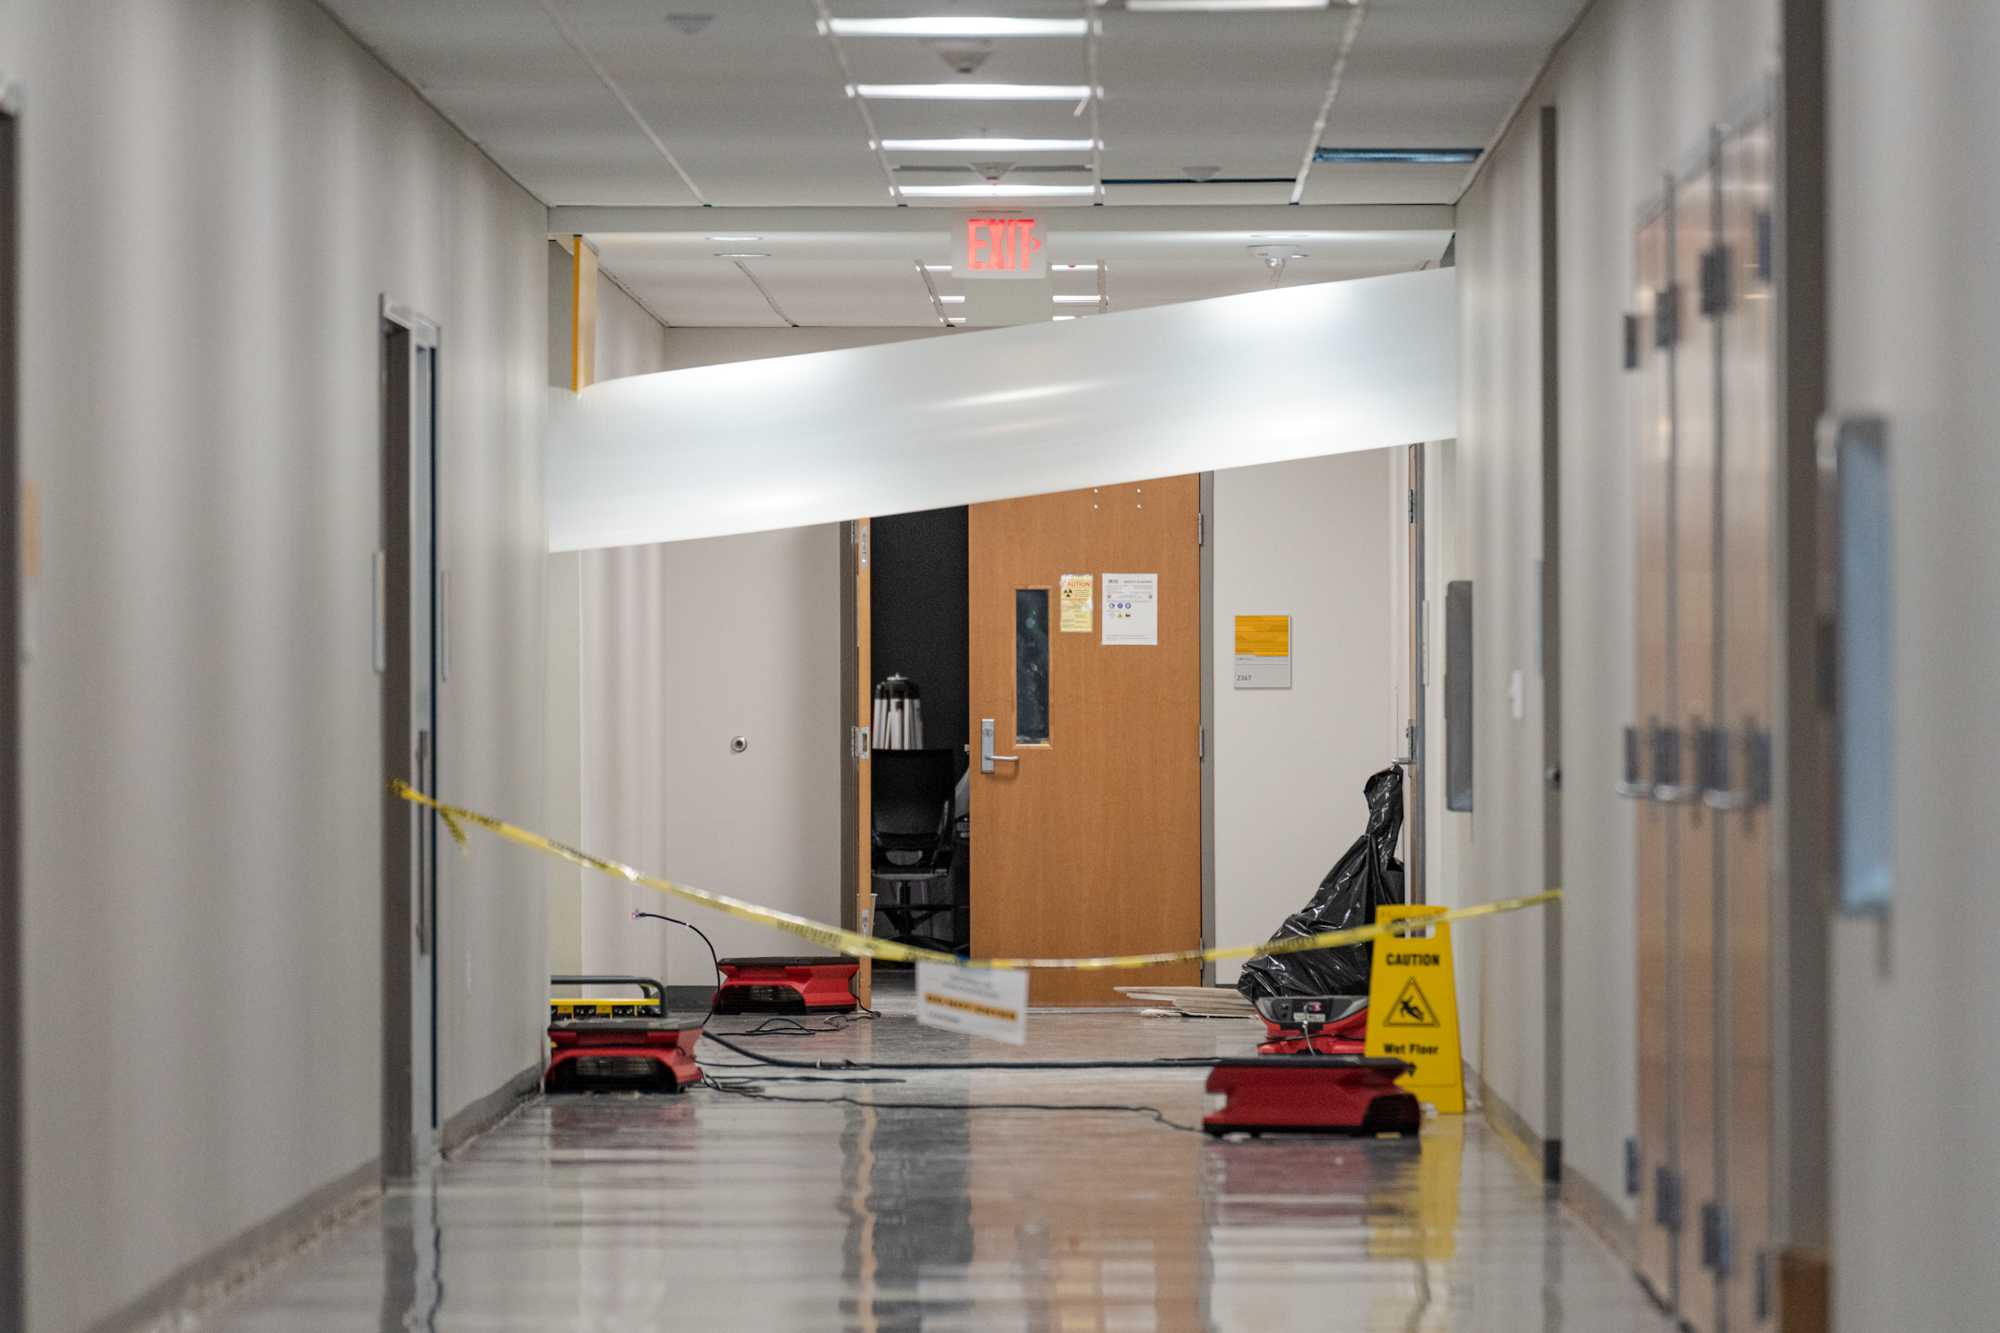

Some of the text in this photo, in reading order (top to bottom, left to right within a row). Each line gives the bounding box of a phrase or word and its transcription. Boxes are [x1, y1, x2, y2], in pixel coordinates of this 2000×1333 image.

[968, 219, 1035, 271] EXIT
[1062, 581, 1090, 589] AUTION
[1386, 953, 1440, 966] CAUTION
[1384, 1044, 1438, 1055] Wet Floor
